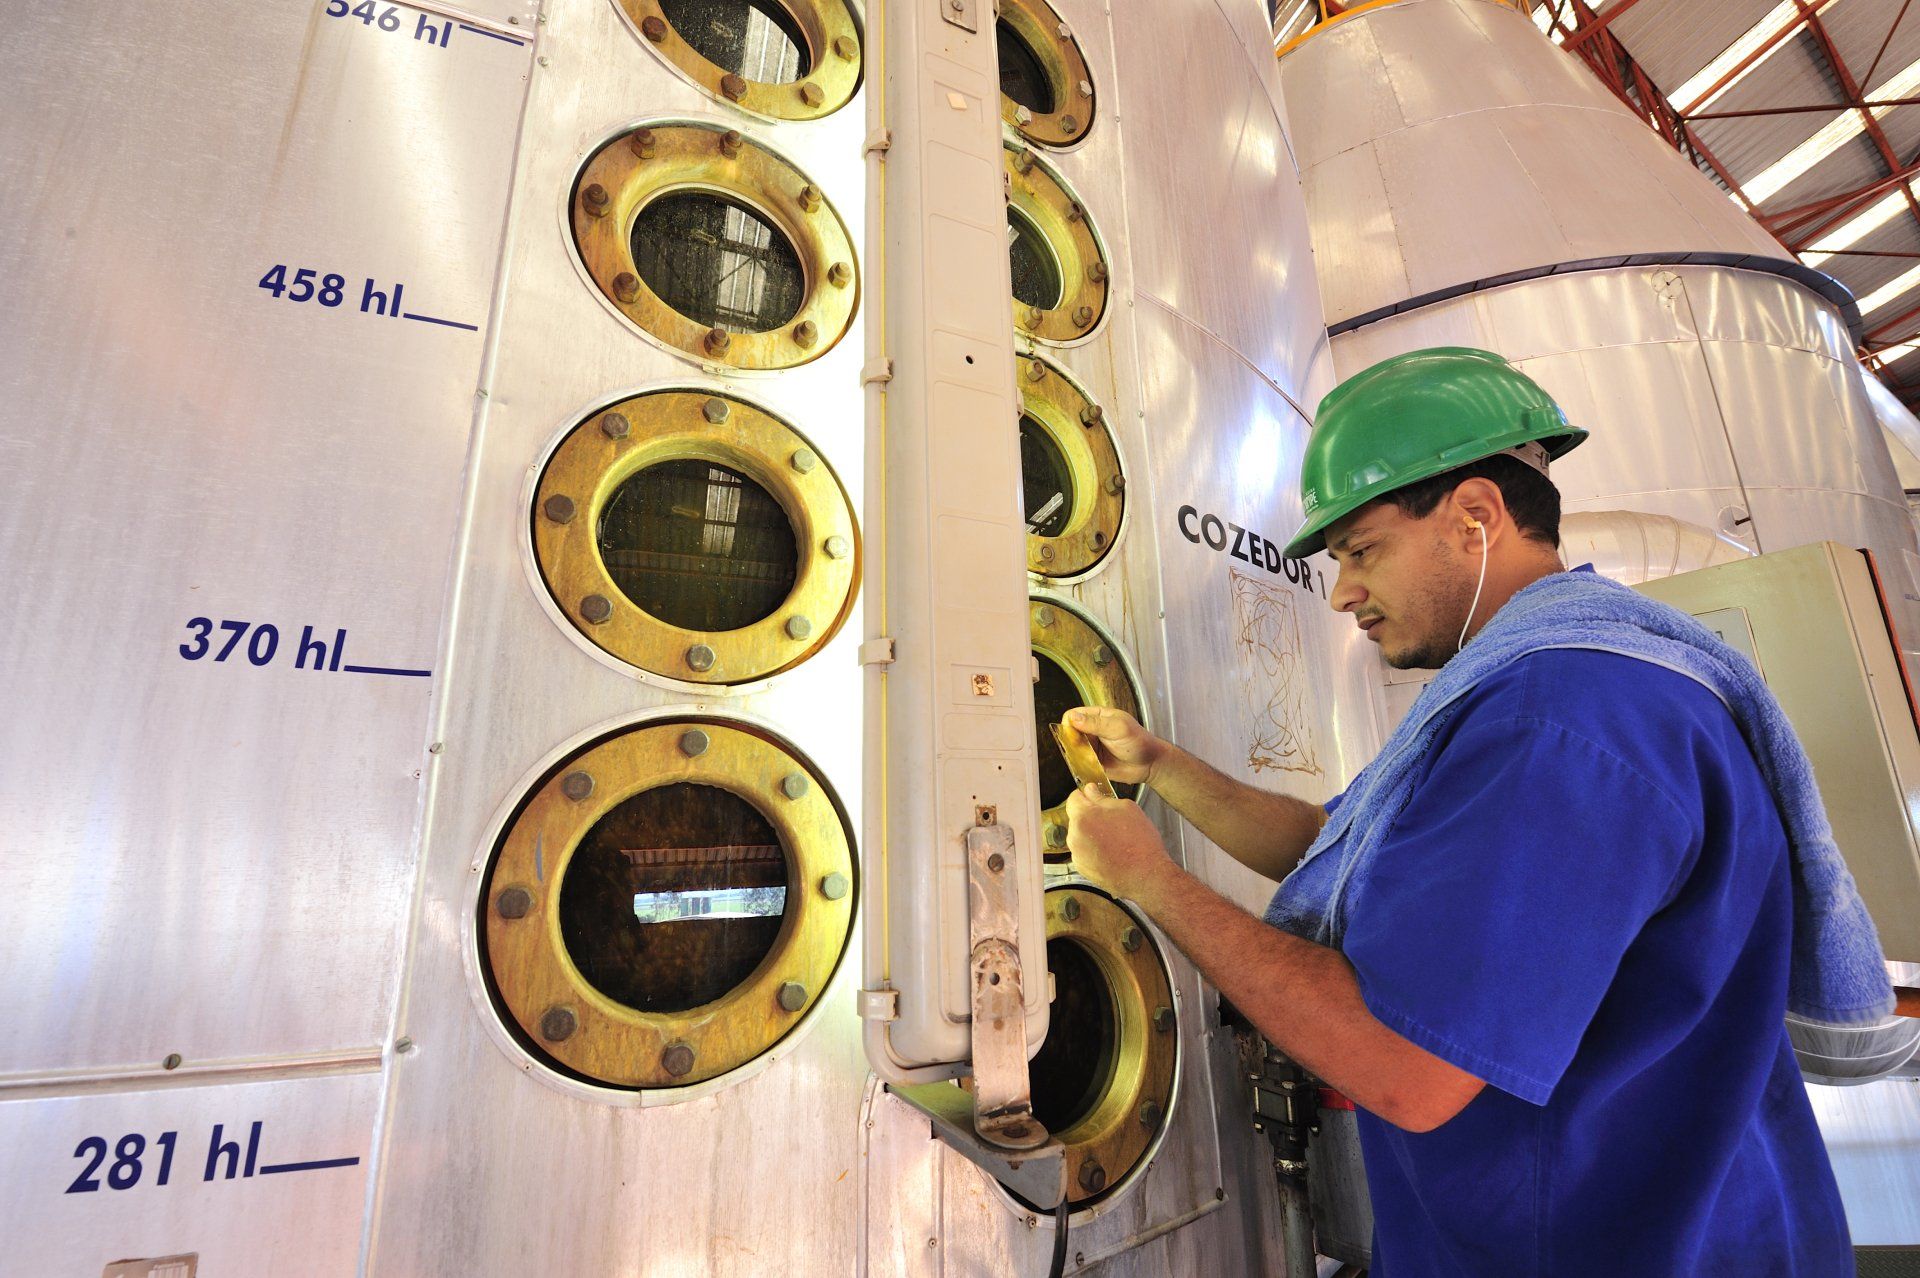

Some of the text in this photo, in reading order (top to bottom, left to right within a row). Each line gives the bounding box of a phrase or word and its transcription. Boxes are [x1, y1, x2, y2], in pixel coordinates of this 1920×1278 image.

[414, 13, 453, 48] hl
[258, 264, 404, 318] 458 hl
[1177, 504, 1327, 600] COZEDOR 1
[180, 616, 347, 672] 370 hl
[64, 1120, 263, 1195] 281 hl
